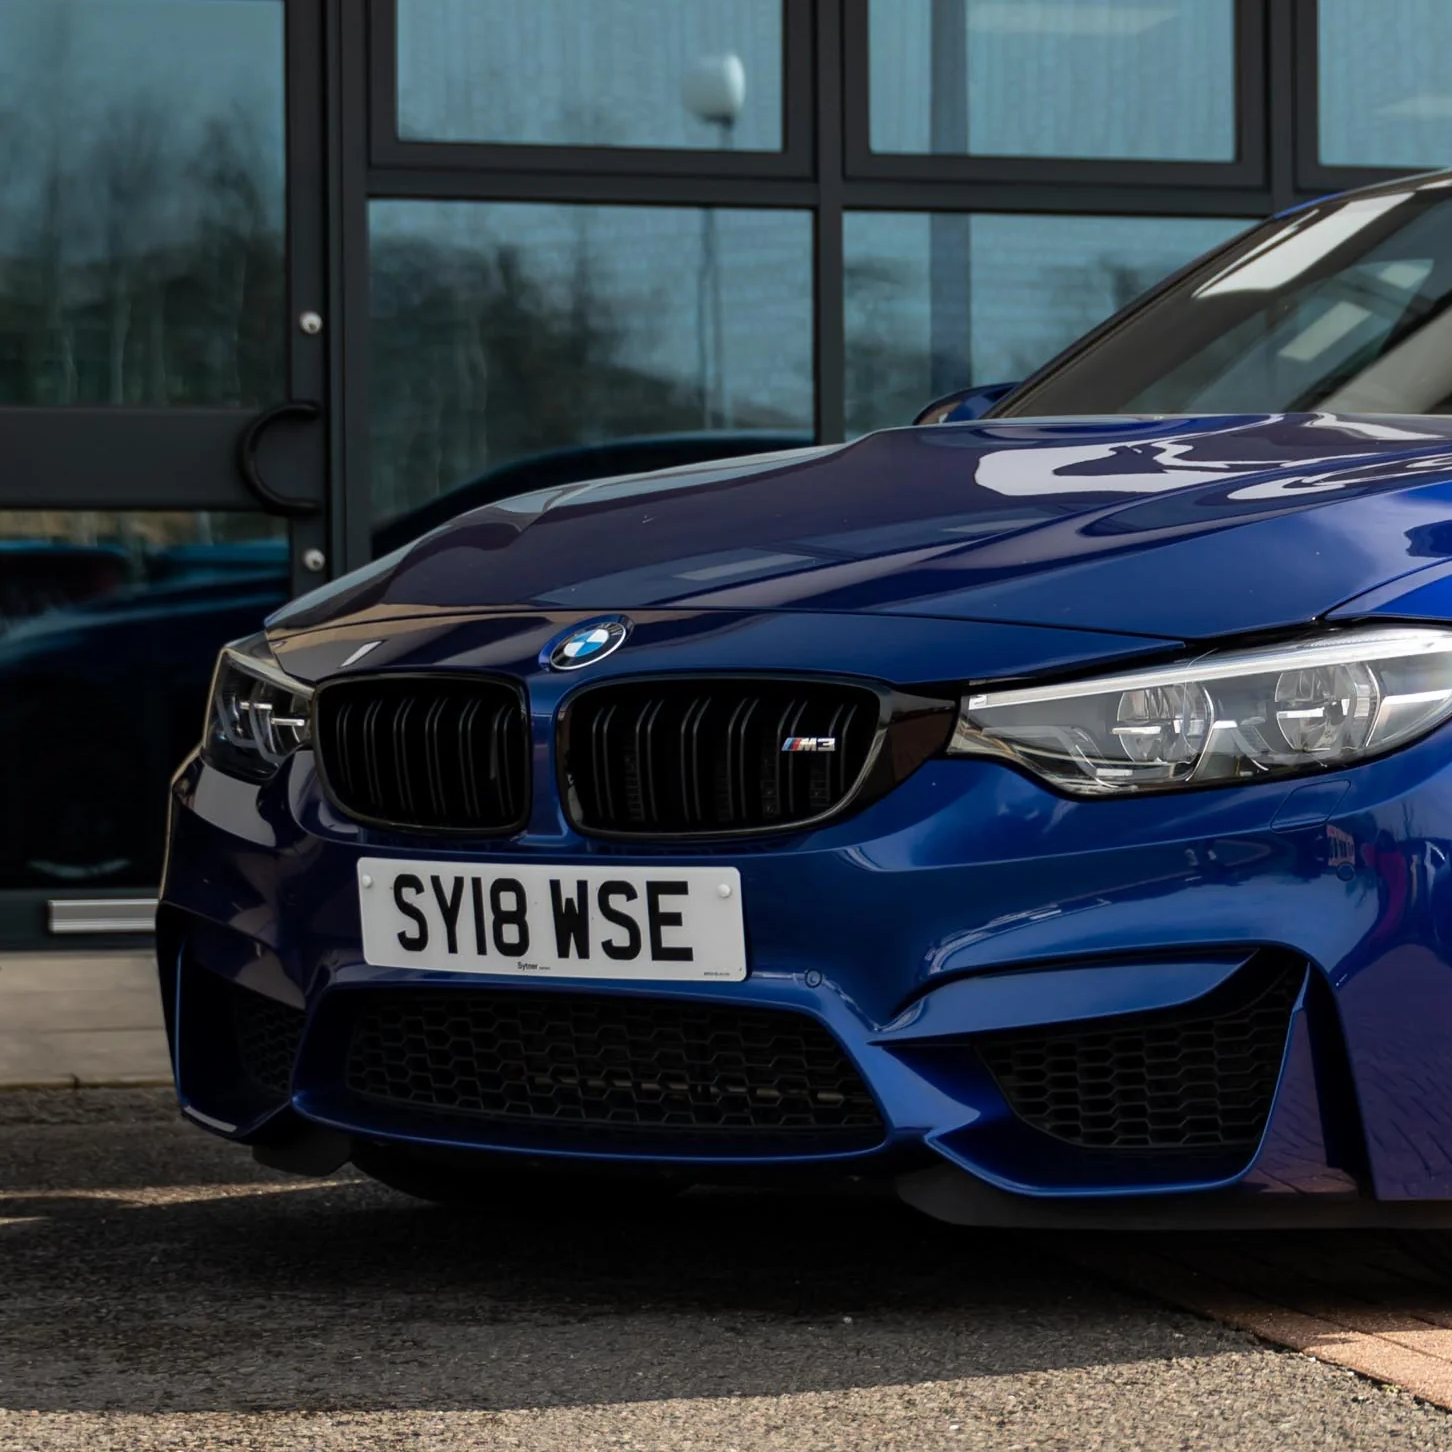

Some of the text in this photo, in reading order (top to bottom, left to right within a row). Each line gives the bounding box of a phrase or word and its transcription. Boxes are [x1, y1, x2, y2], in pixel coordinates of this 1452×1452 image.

[798, 737, 836, 752] M3
[393, 873, 694, 962] SY18 WSE
[516, 960, 539, 971] Sytner
